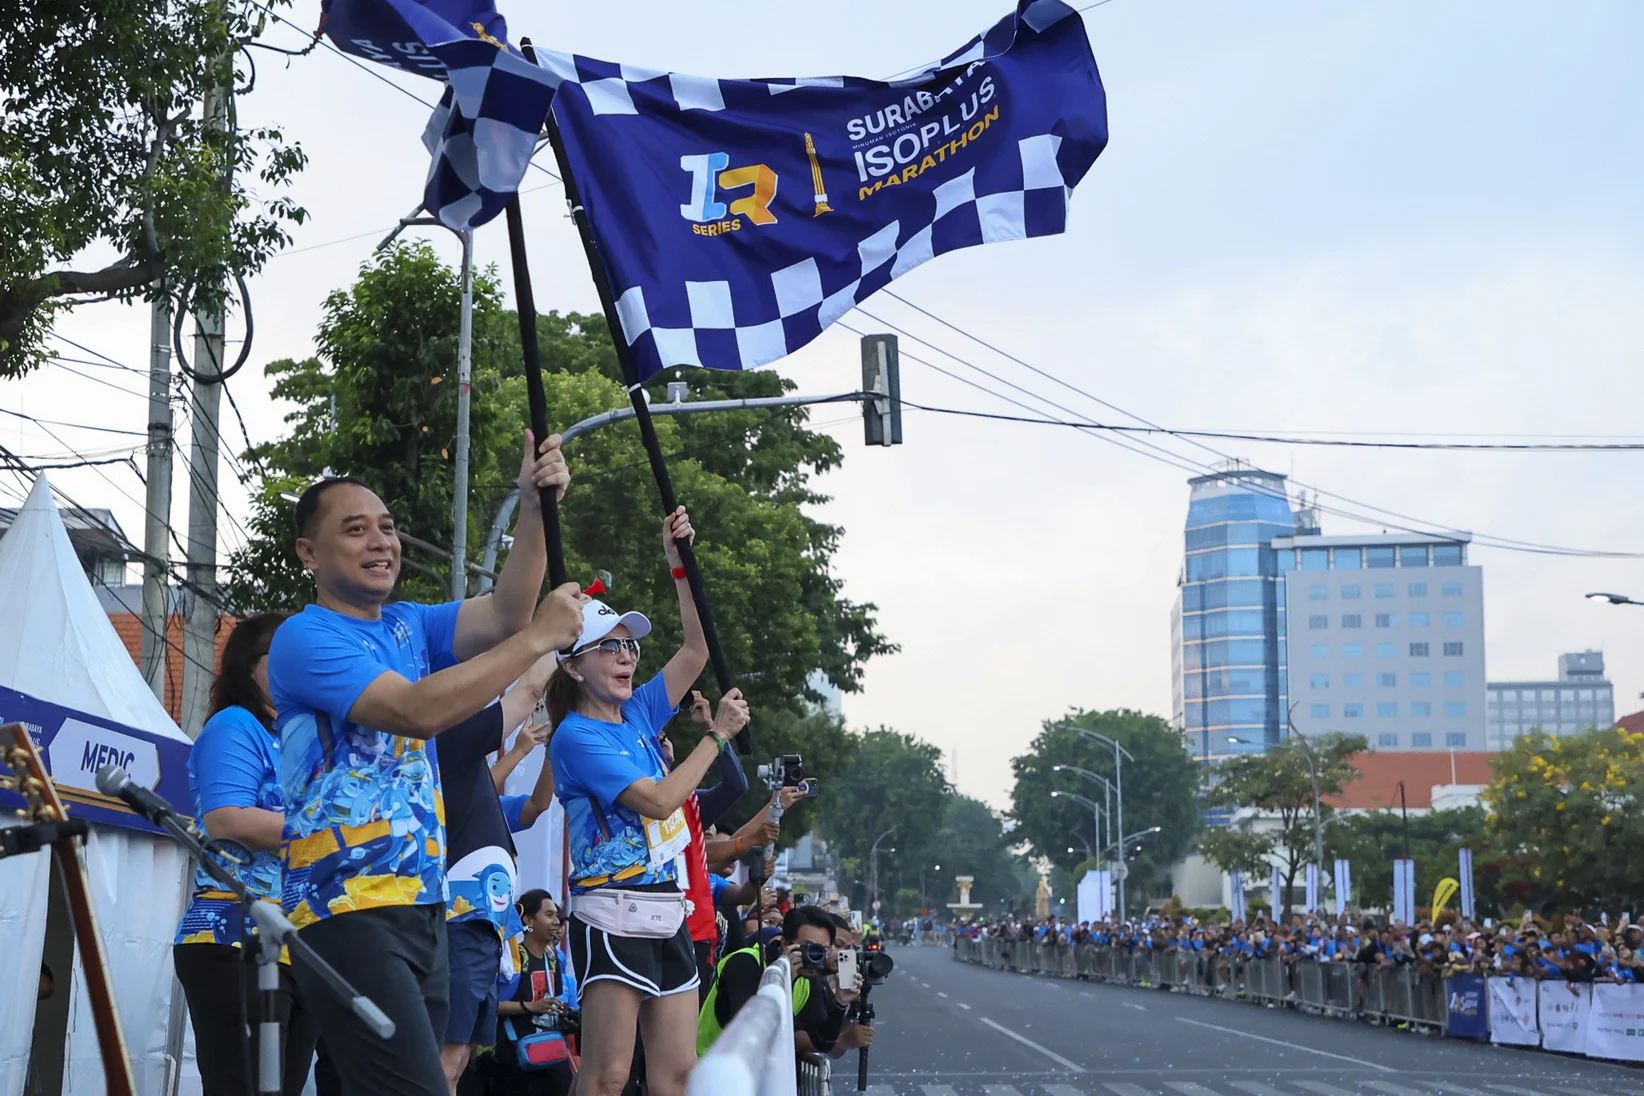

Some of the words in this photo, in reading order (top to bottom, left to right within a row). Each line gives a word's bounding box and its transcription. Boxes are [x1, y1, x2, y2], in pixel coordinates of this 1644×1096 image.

[852, 136, 884, 150] MINUMAN
[854, 76, 996, 183] ISOPLUS
[858, 105, 1000, 201] MARATHON
[692, 218, 742, 237] SERIES
